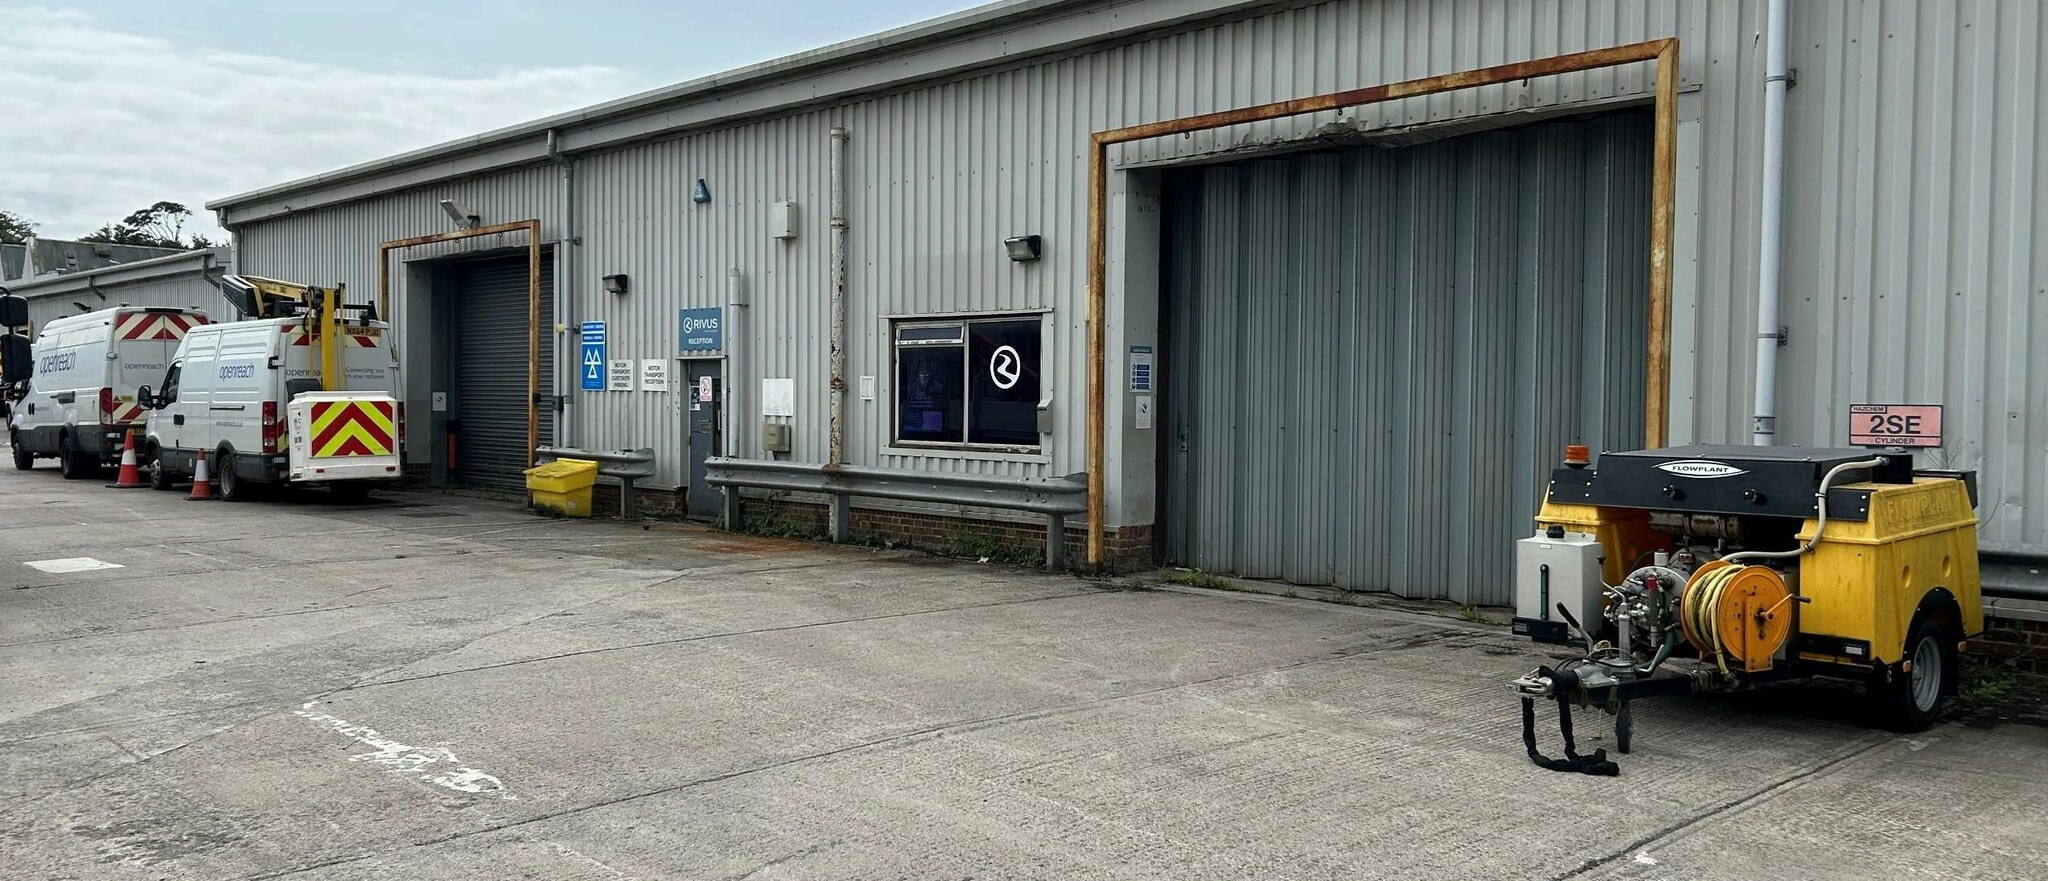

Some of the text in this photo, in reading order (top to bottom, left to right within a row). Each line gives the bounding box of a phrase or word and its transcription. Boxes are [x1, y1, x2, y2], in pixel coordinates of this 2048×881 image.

[693, 318, 719, 330] RIVUS
[688, 337, 713, 345] RECEPTION
[39, 350, 77, 377] openreach
[124, 362, 165, 371] openreach
[219, 362, 255, 382] openreach
[1869, 414, 1922, 435] 2SE
[1874, 437, 1916, 445] CYLINDER
[1672, 465, 1729, 473] FLOWPLANT
